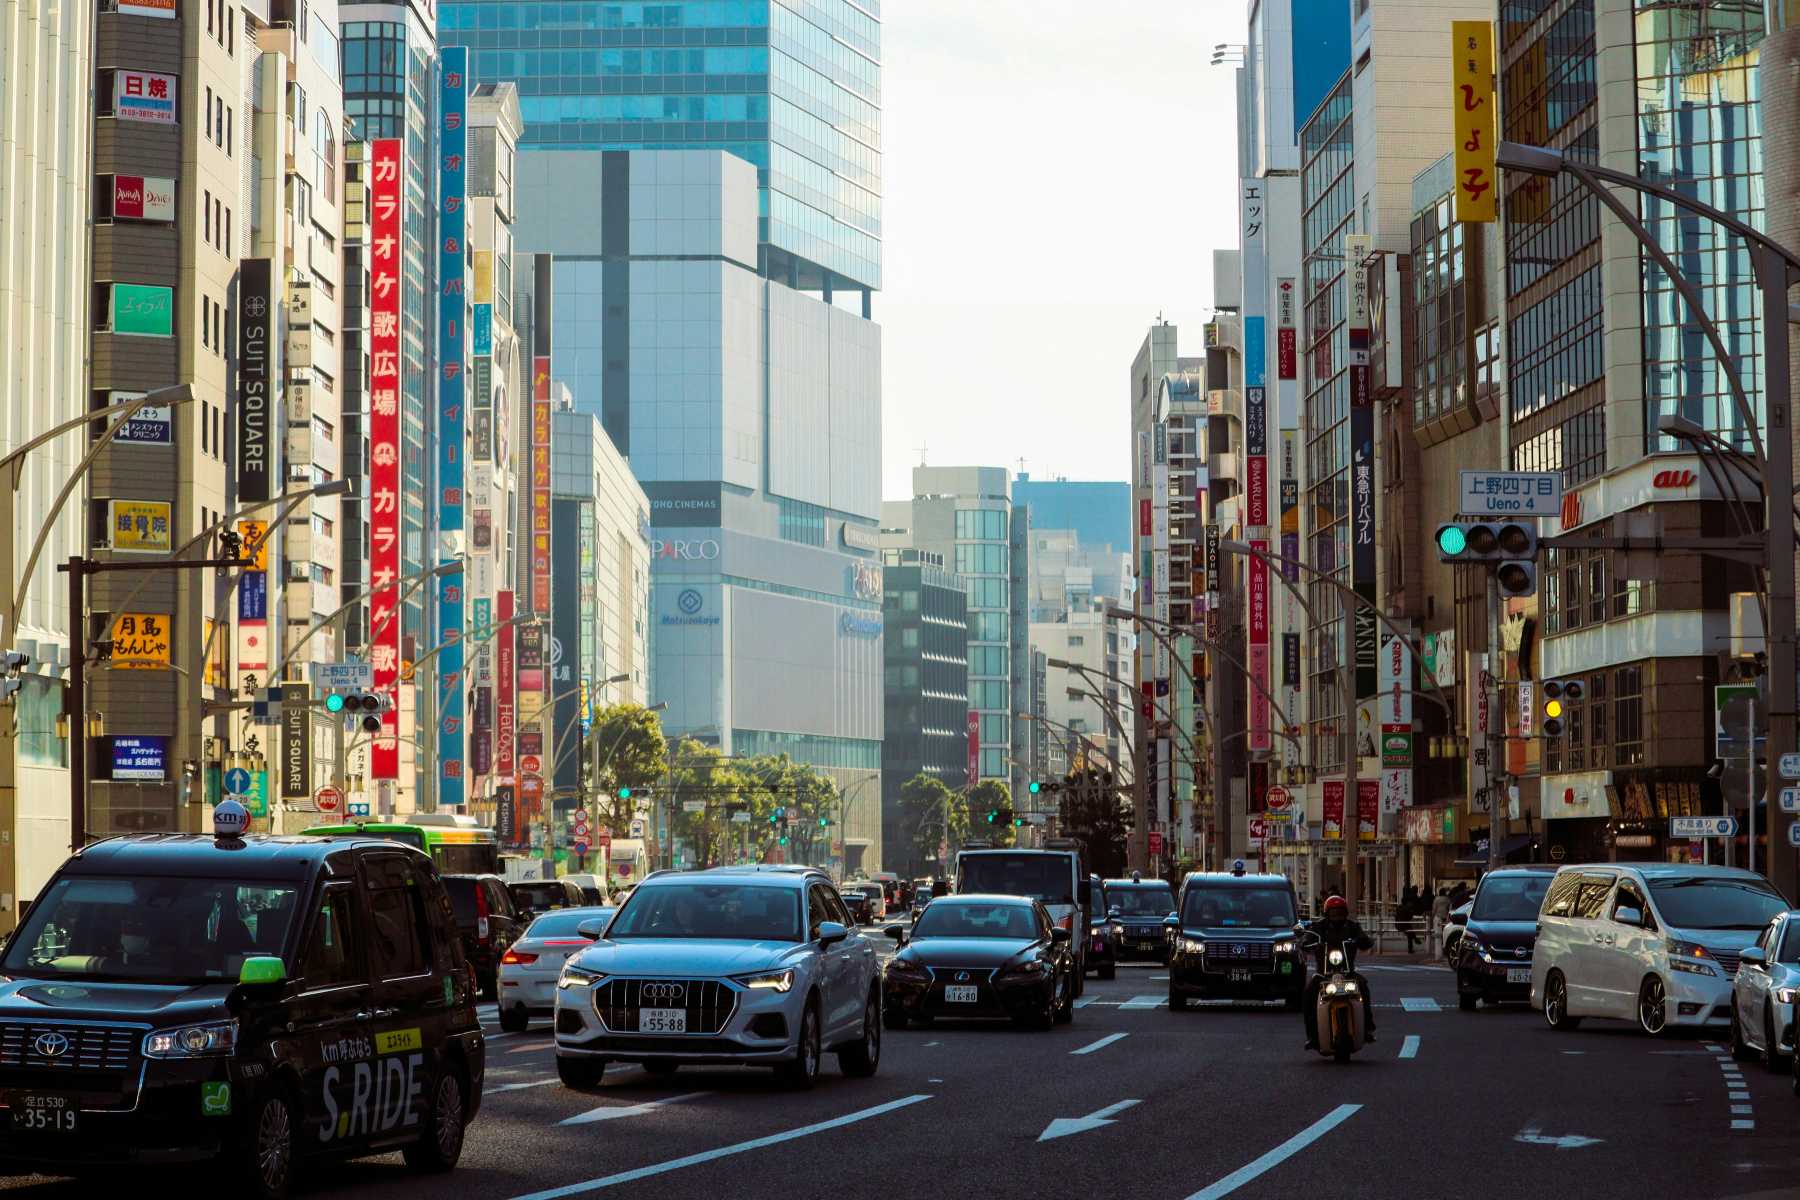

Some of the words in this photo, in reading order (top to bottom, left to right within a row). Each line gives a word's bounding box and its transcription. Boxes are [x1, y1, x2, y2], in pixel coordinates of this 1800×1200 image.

[126, 75, 168, 99] 日焼
[1460, 84, 1489, 201] ひよ子
[373, 156, 397, 416] カラオケ歌広場
[246, 326, 264, 375] SUIT
[245, 381, 264, 473] SQUARE
[1469, 477, 1552, 495] 上野四丁目
[1653, 469, 1697, 488] au
[674, 500, 716, 509] CINEMAS
[1357, 466, 1372, 544] 東急リバブル
[1487, 498, 1520, 509] Ueno
[1526, 498, 1534, 509] 4
[117, 514, 167, 533] 接骨院
[651, 539, 720, 560] PARCO
[120, 618, 161, 636] 月島
[476, 602, 488, 638] NOVA
[114, 640, 167, 655] もんじゃ
[321, 666, 368, 677] 上野四丁目
[443, 586, 462, 777] カラオケ館
[290, 709, 301, 736] SUIT
[499, 702, 513, 762] Hatoya
[289, 740, 301, 790] SQUARE
[650, 1018, 683, 1031] 55-88
[319, 1053, 423, 1142] S.RIDE
[25, 1109, 75, 1130] 35-19
